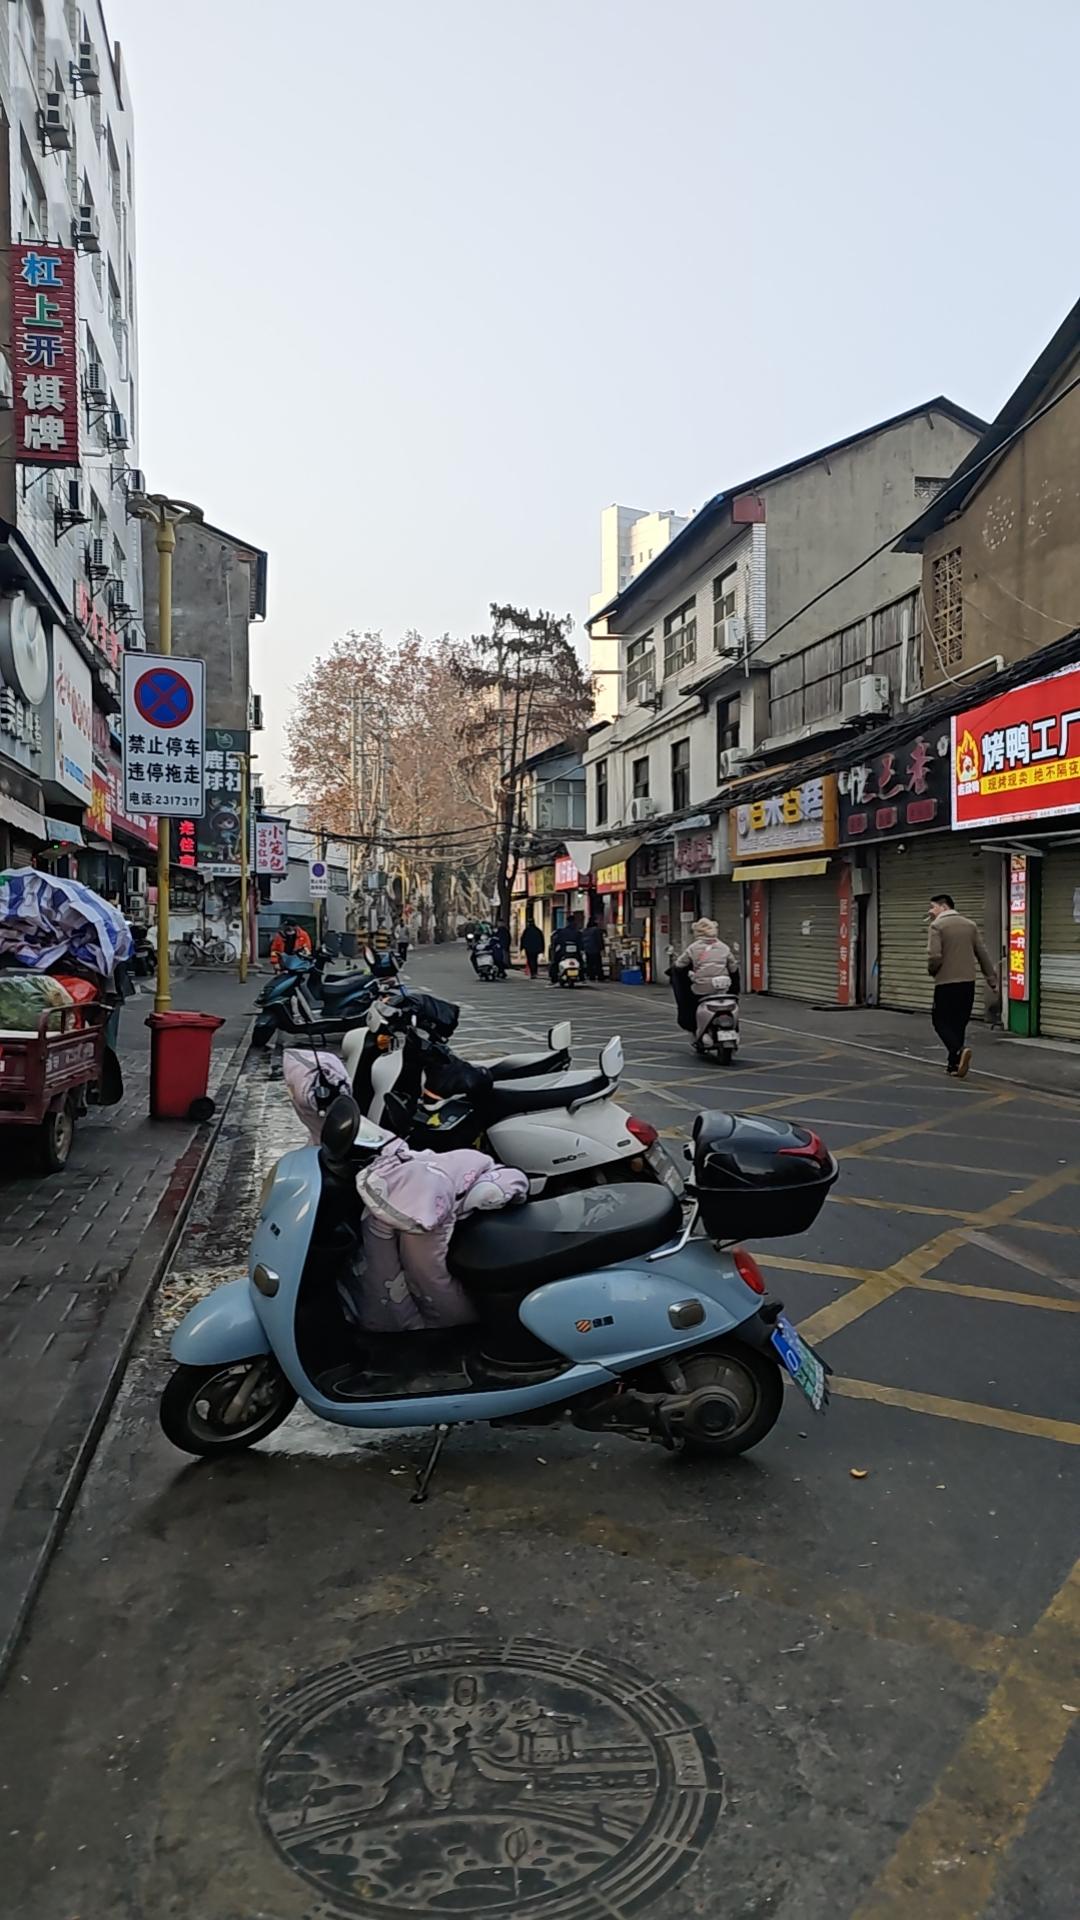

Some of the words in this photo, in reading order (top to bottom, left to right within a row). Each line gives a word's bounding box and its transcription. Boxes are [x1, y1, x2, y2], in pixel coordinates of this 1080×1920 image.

[22, 252, 67, 451] 杠上开棋牌
[128, 734, 200, 758] 禁止停车
[981, 709, 1080, 774] 烤鸭工厂
[128, 762, 200, 784] 违停拖走
[988, 772, 1029, 791] 现烤现卖
[1034, 760, 1080, 782] 绝不隔夜
[129, 791, 200, 807] 电话:2317317
[269, 825, 284, 871] 小笼包
